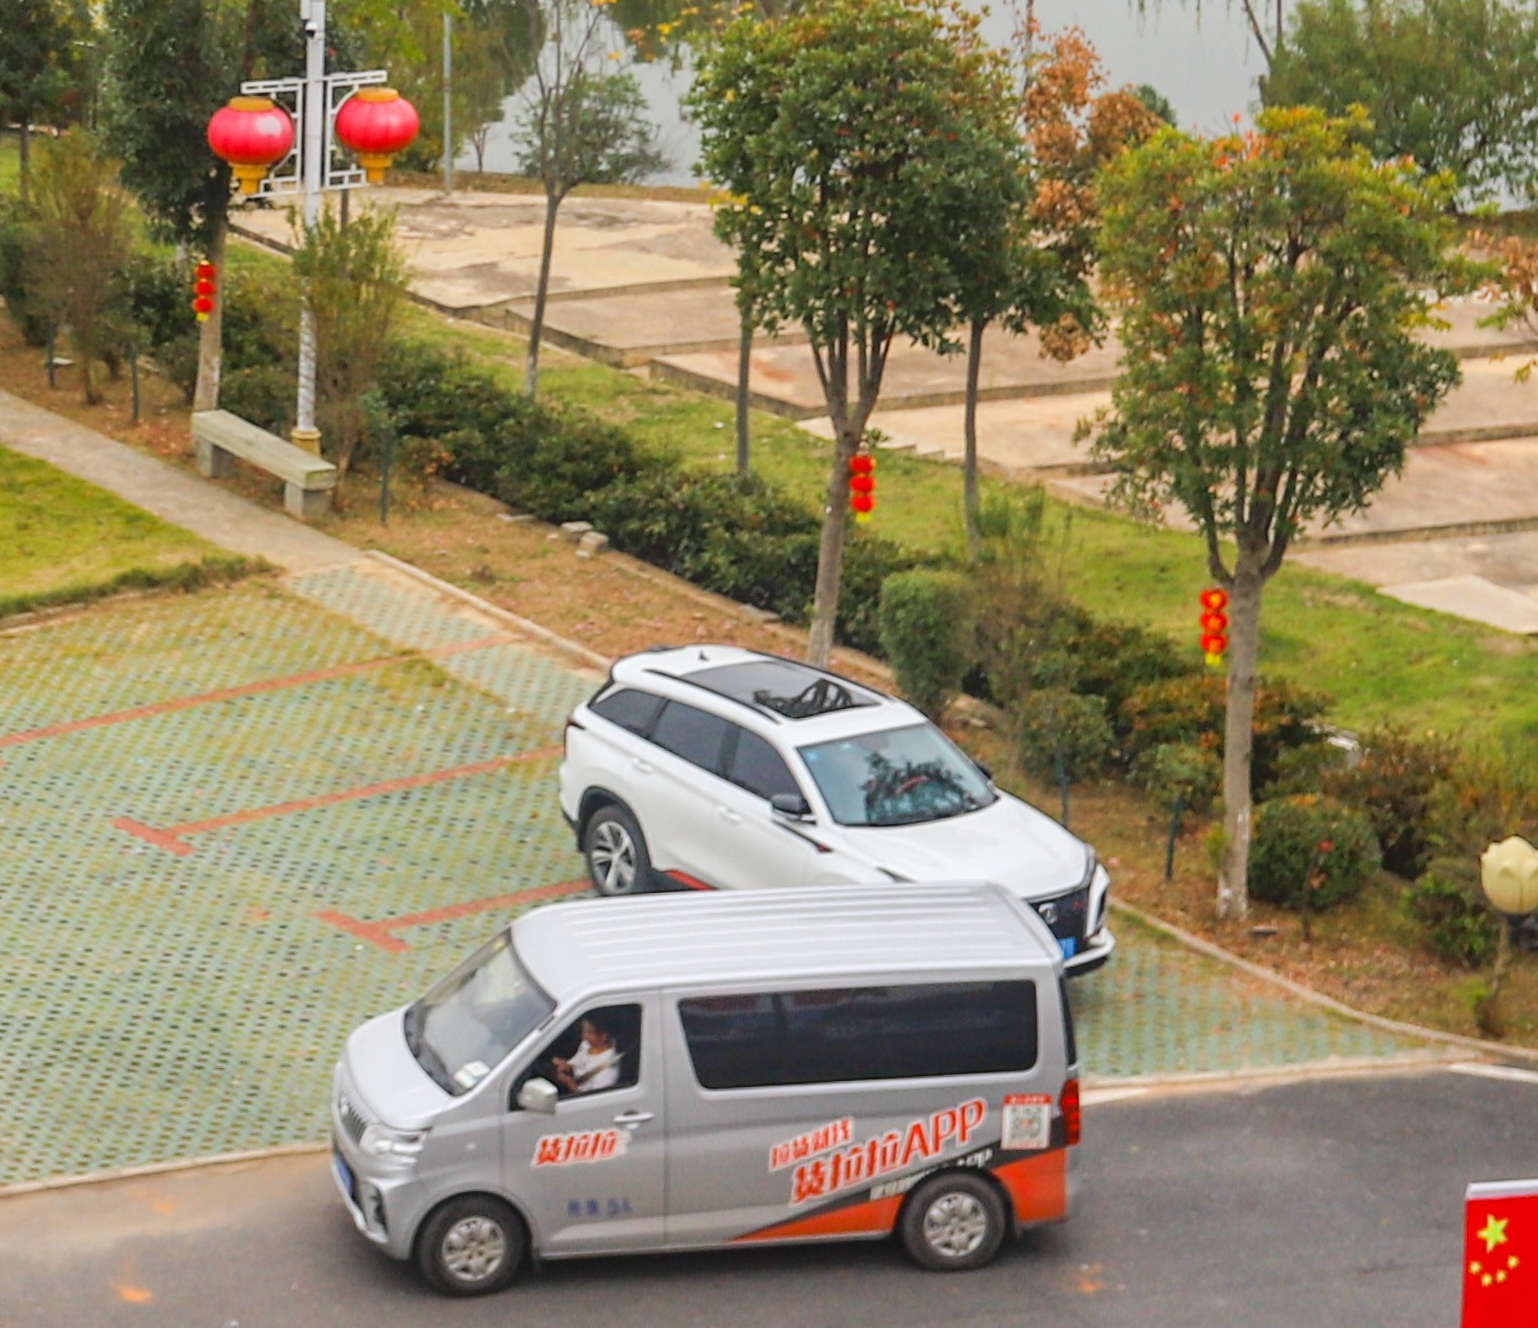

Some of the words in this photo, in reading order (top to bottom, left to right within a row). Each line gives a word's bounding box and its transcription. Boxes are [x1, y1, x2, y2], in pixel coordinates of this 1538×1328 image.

[533, 1128, 622, 1167] 货拉拉
[790, 1098, 986, 1205] 货拉拉APP
